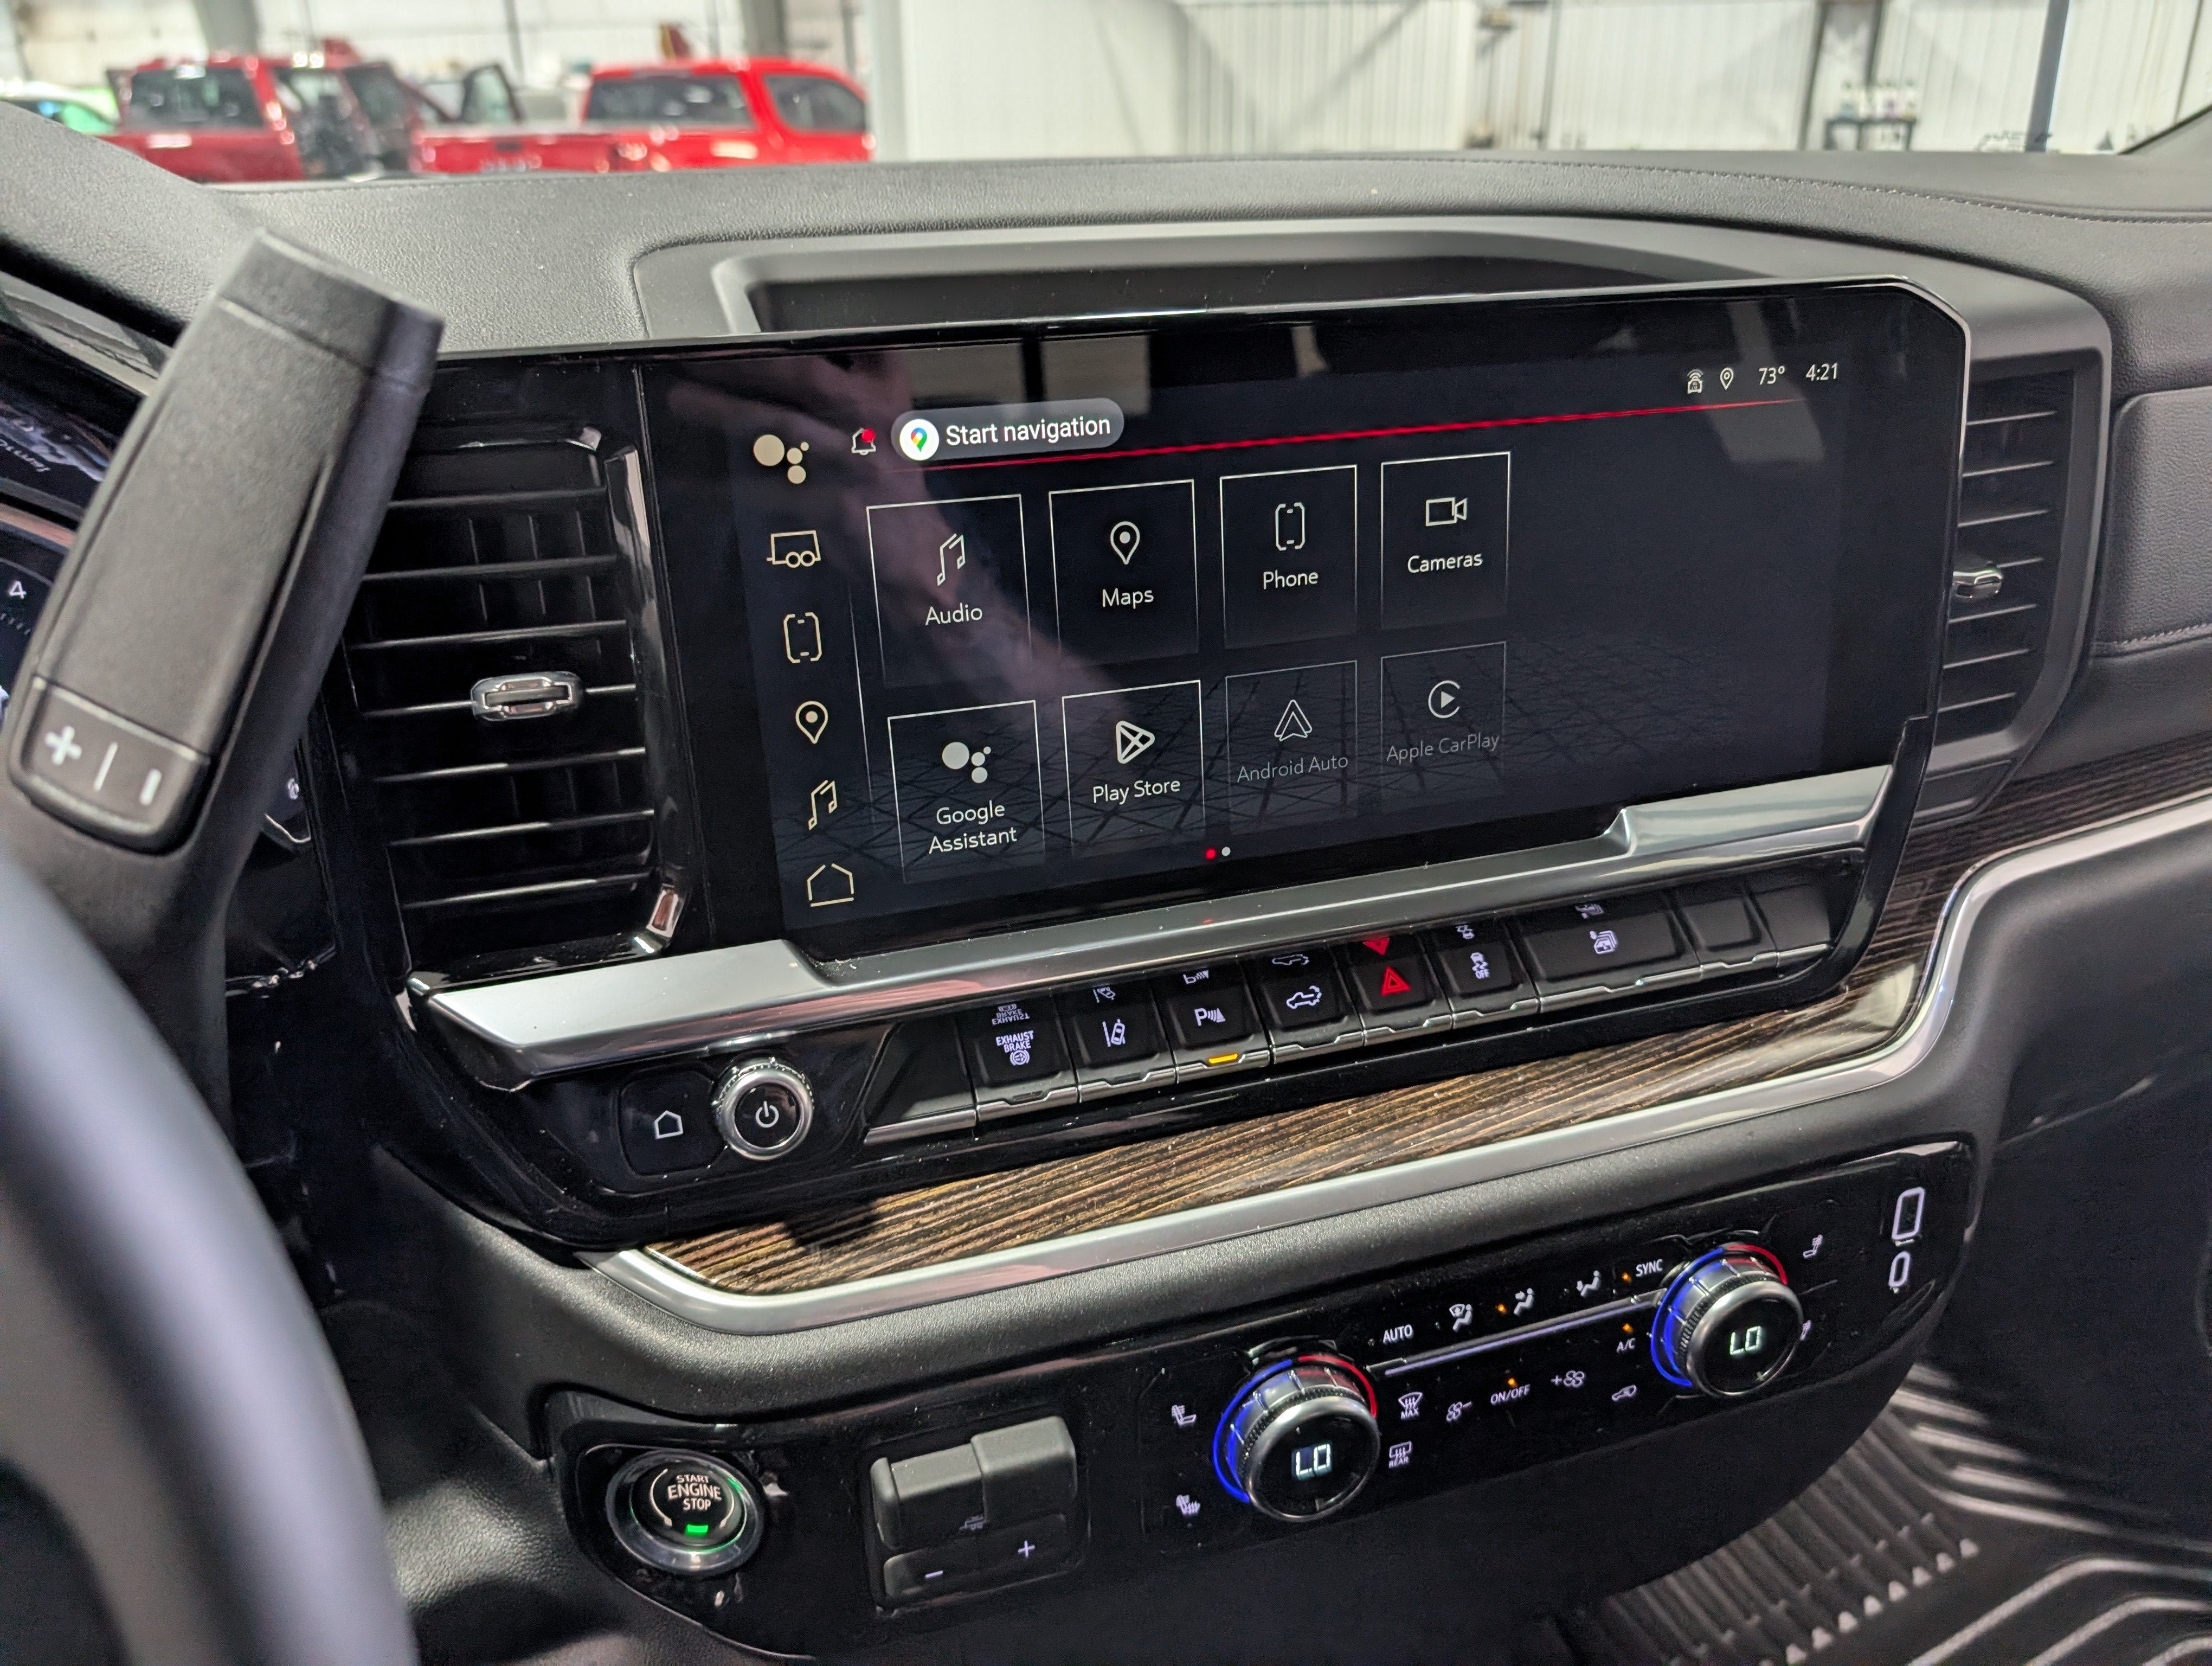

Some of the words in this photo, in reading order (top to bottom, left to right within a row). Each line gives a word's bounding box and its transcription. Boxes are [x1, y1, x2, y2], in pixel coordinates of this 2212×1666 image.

[1805, 362, 1838, 382] 4:21
[946, 424, 998, 446] Start
[1003, 416, 1111, 444] navigation
[1407, 552, 1483, 574] Cameras
[1262, 568, 1319, 590] Phone
[1102, 587, 1154, 609] Maps
[924, 603, 983, 626] Audio
[1386, 740, 1433, 764] Apple
[1438, 732, 1500, 755] CarPlay
[1237, 759, 1303, 783] Android
[1308, 754, 1349, 773] Auto
[1093, 784, 1129, 806] Play
[1134, 778, 1181, 799] Store
[936, 800, 1006, 826] Google
[928, 828, 1018, 854] Assistant
[995, 1030, 1034, 1046] EXHAUST
[1004, 1040, 1032, 1053] BRAKE
[1636, 1259, 1663, 1277] SYNC
[1382, 1324, 1413, 1344] AUTO
[1616, 1337, 1636, 1353] A/C
[1491, 1383, 1529, 1405] ON/OFF
[1400, 1407, 1420, 1420] MAX
[1388, 1455, 1410, 1469] REAR
[676, 1474, 709, 1483] START
[667, 1483, 722, 1501] ENGINE
[683, 1498, 711, 1511] STOP
